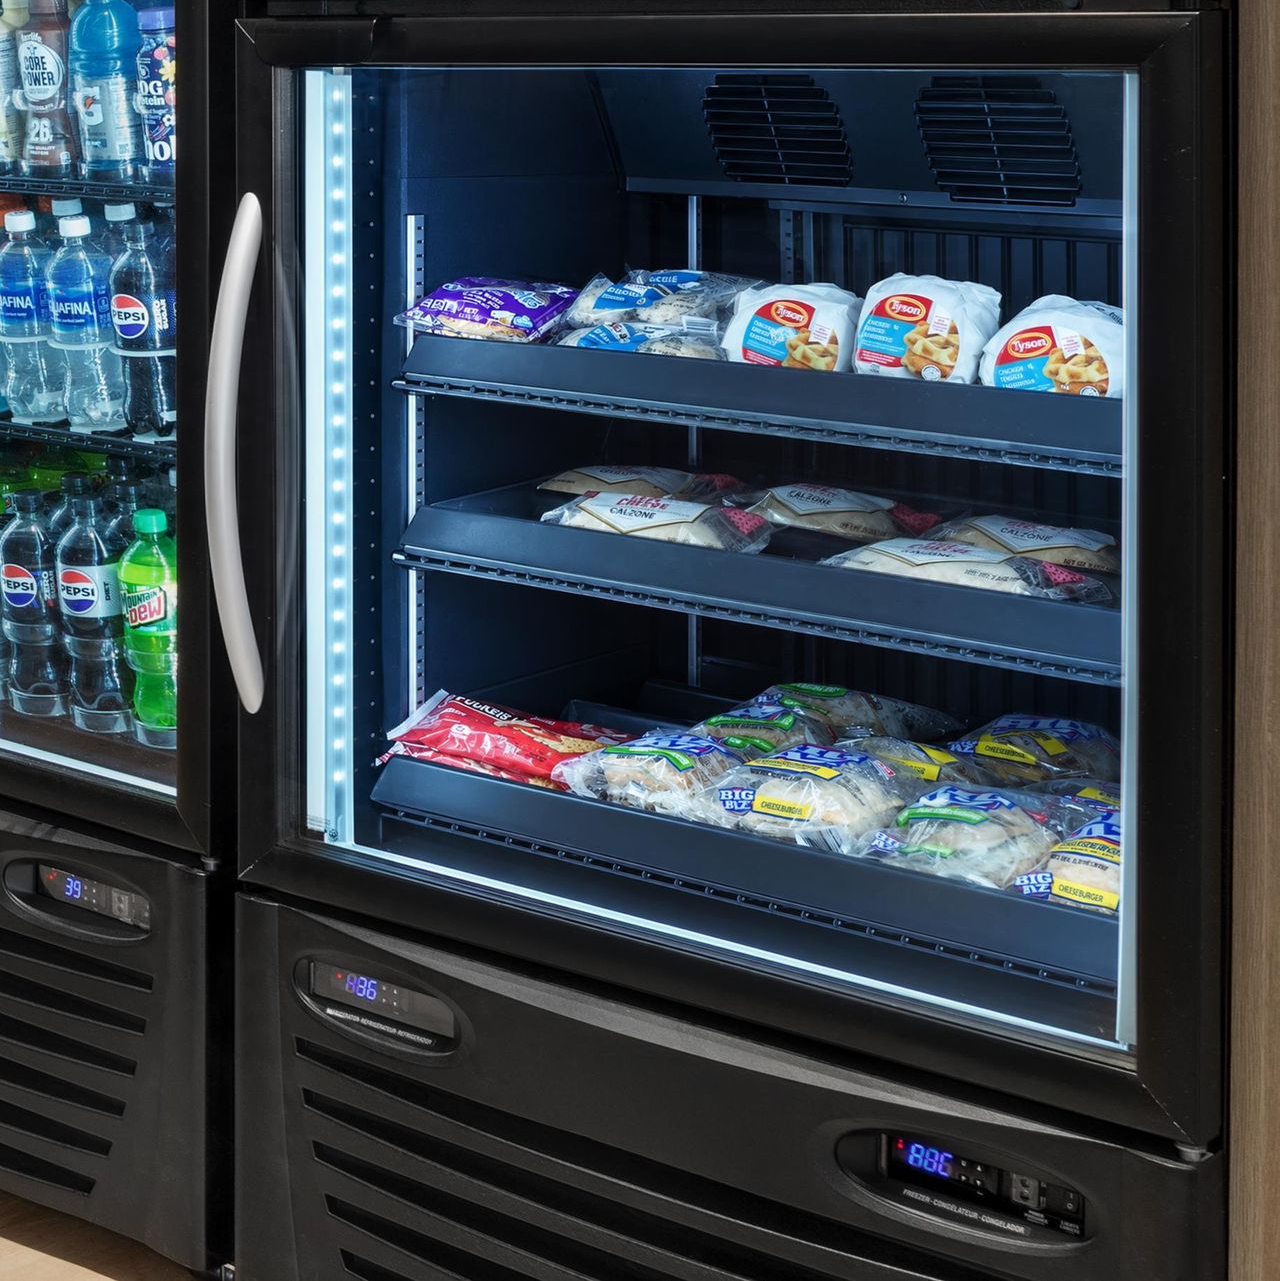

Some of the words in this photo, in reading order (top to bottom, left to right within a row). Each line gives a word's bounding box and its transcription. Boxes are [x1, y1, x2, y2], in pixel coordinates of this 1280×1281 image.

[24, 56, 47, 70] CORE
[24, 71, 56, 87] POWER
[776, 305, 804, 323] Tyson
[891, 300, 921, 316] Tyson
[113, 311, 145, 323] PEPSI
[1011, 338, 1047, 352] Tyson
[790, 490, 832, 507] CALZONE
[610, 507, 656, 519] CALZONE
[1000, 527, 1054, 542] CALZONE
[2, 578, 34, 593] PEPSI
[61, 584, 96, 598] PEPSI
[720, 790, 754, 800] BIG
[1015, 873, 1052, 886] BIG
[65, 877, 82, 899] 39
[1058, 883, 1104, 903] CHEESEBURGER
[902, 1189, 930, 1204] FREEZER
[981, 1215, 1025, 1234] CONGELADOR
